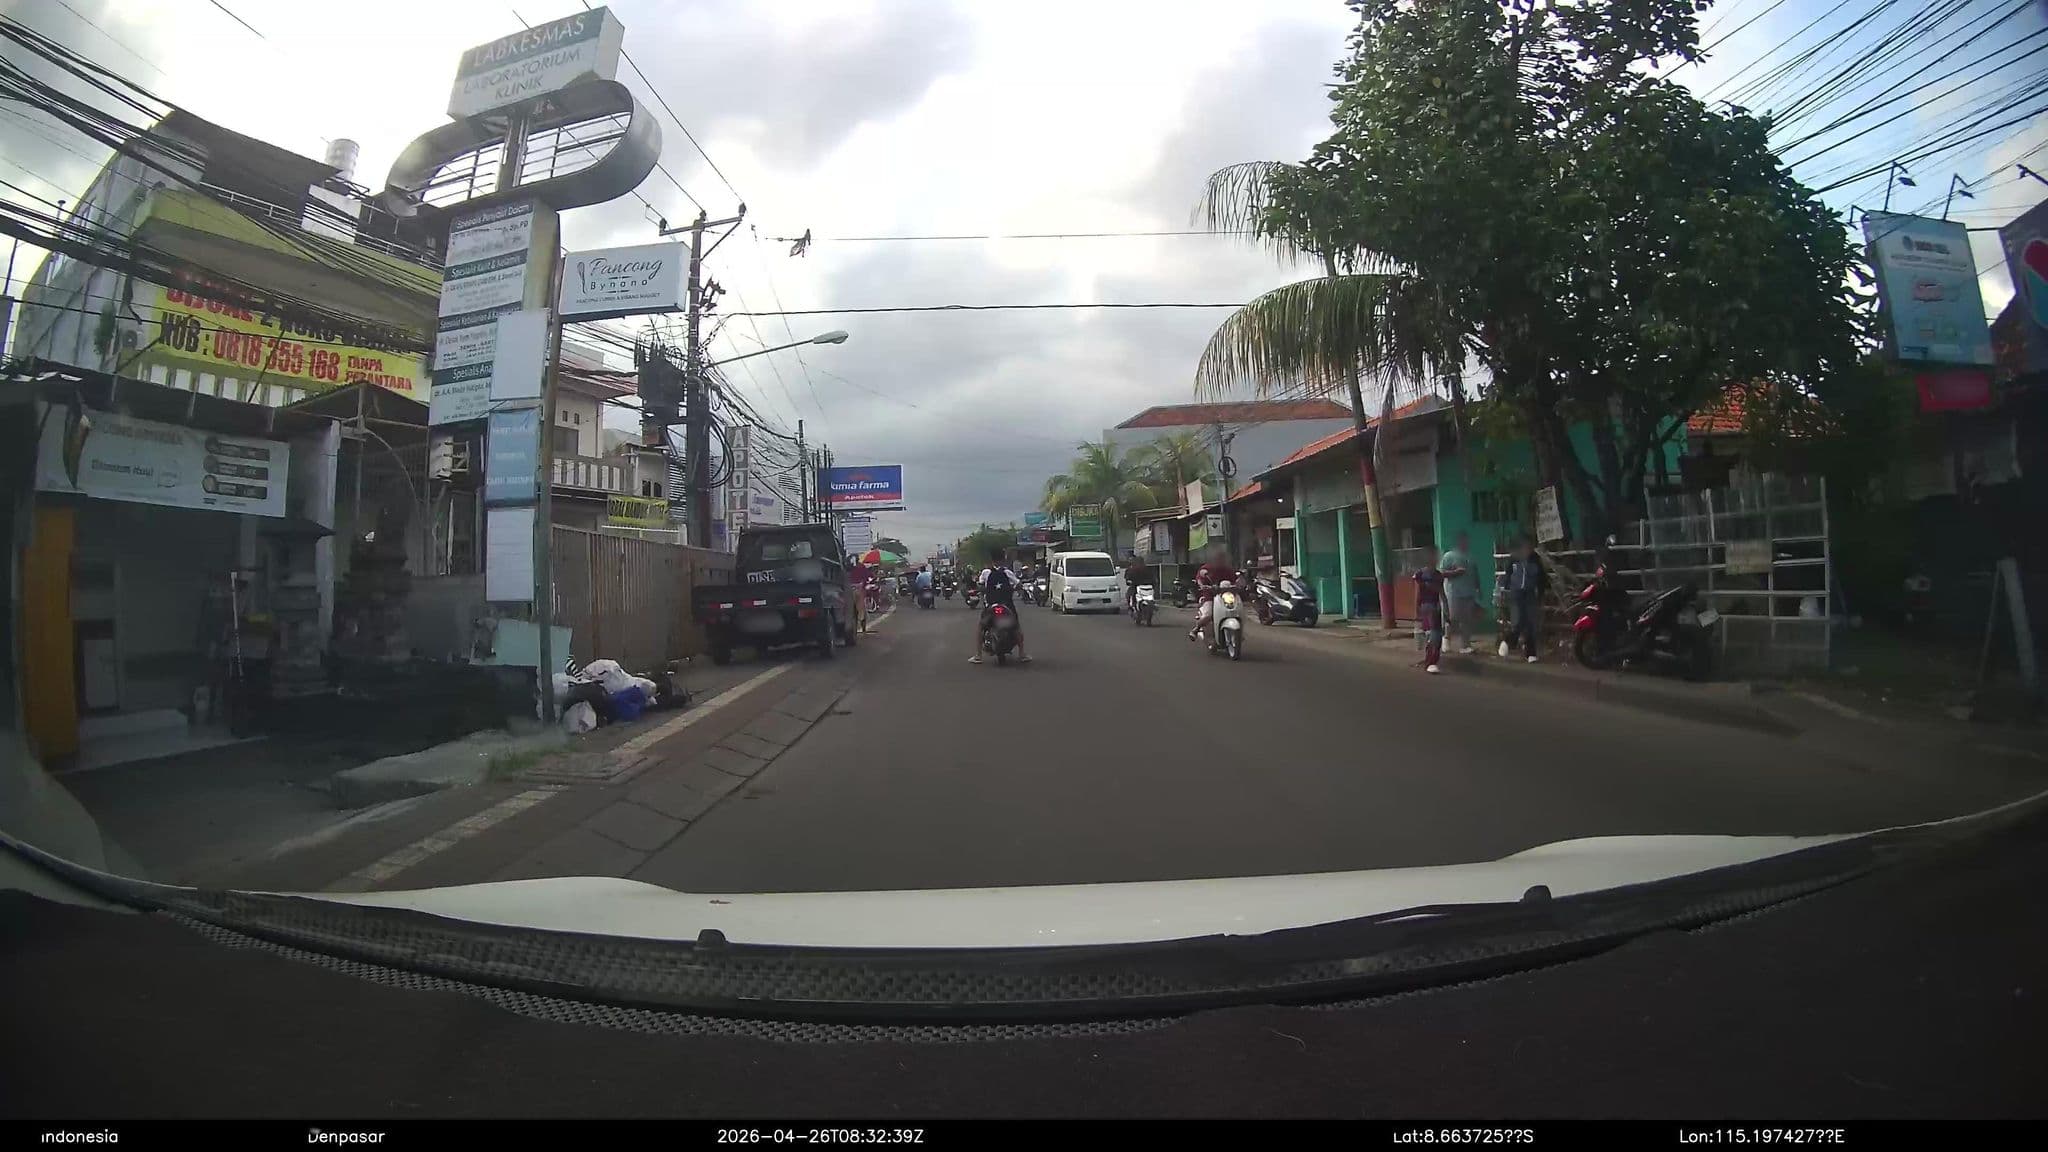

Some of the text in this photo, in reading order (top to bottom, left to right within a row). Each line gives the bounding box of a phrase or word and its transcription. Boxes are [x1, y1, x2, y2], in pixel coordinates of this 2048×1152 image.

[473, 14, 586, 67] LABKESMAS
[463, 48, 581, 95] LABORATORIUM
[494, 75, 543, 100] KLINIK
[589, 257, 663, 281] Pancong
[212, 328, 262, 367] 0818
[266, 337, 304, 376] 355
[307, 348, 341, 383] 168
[347, 355, 383, 373] TANPA
[830, 480, 889, 491] kimia farma
